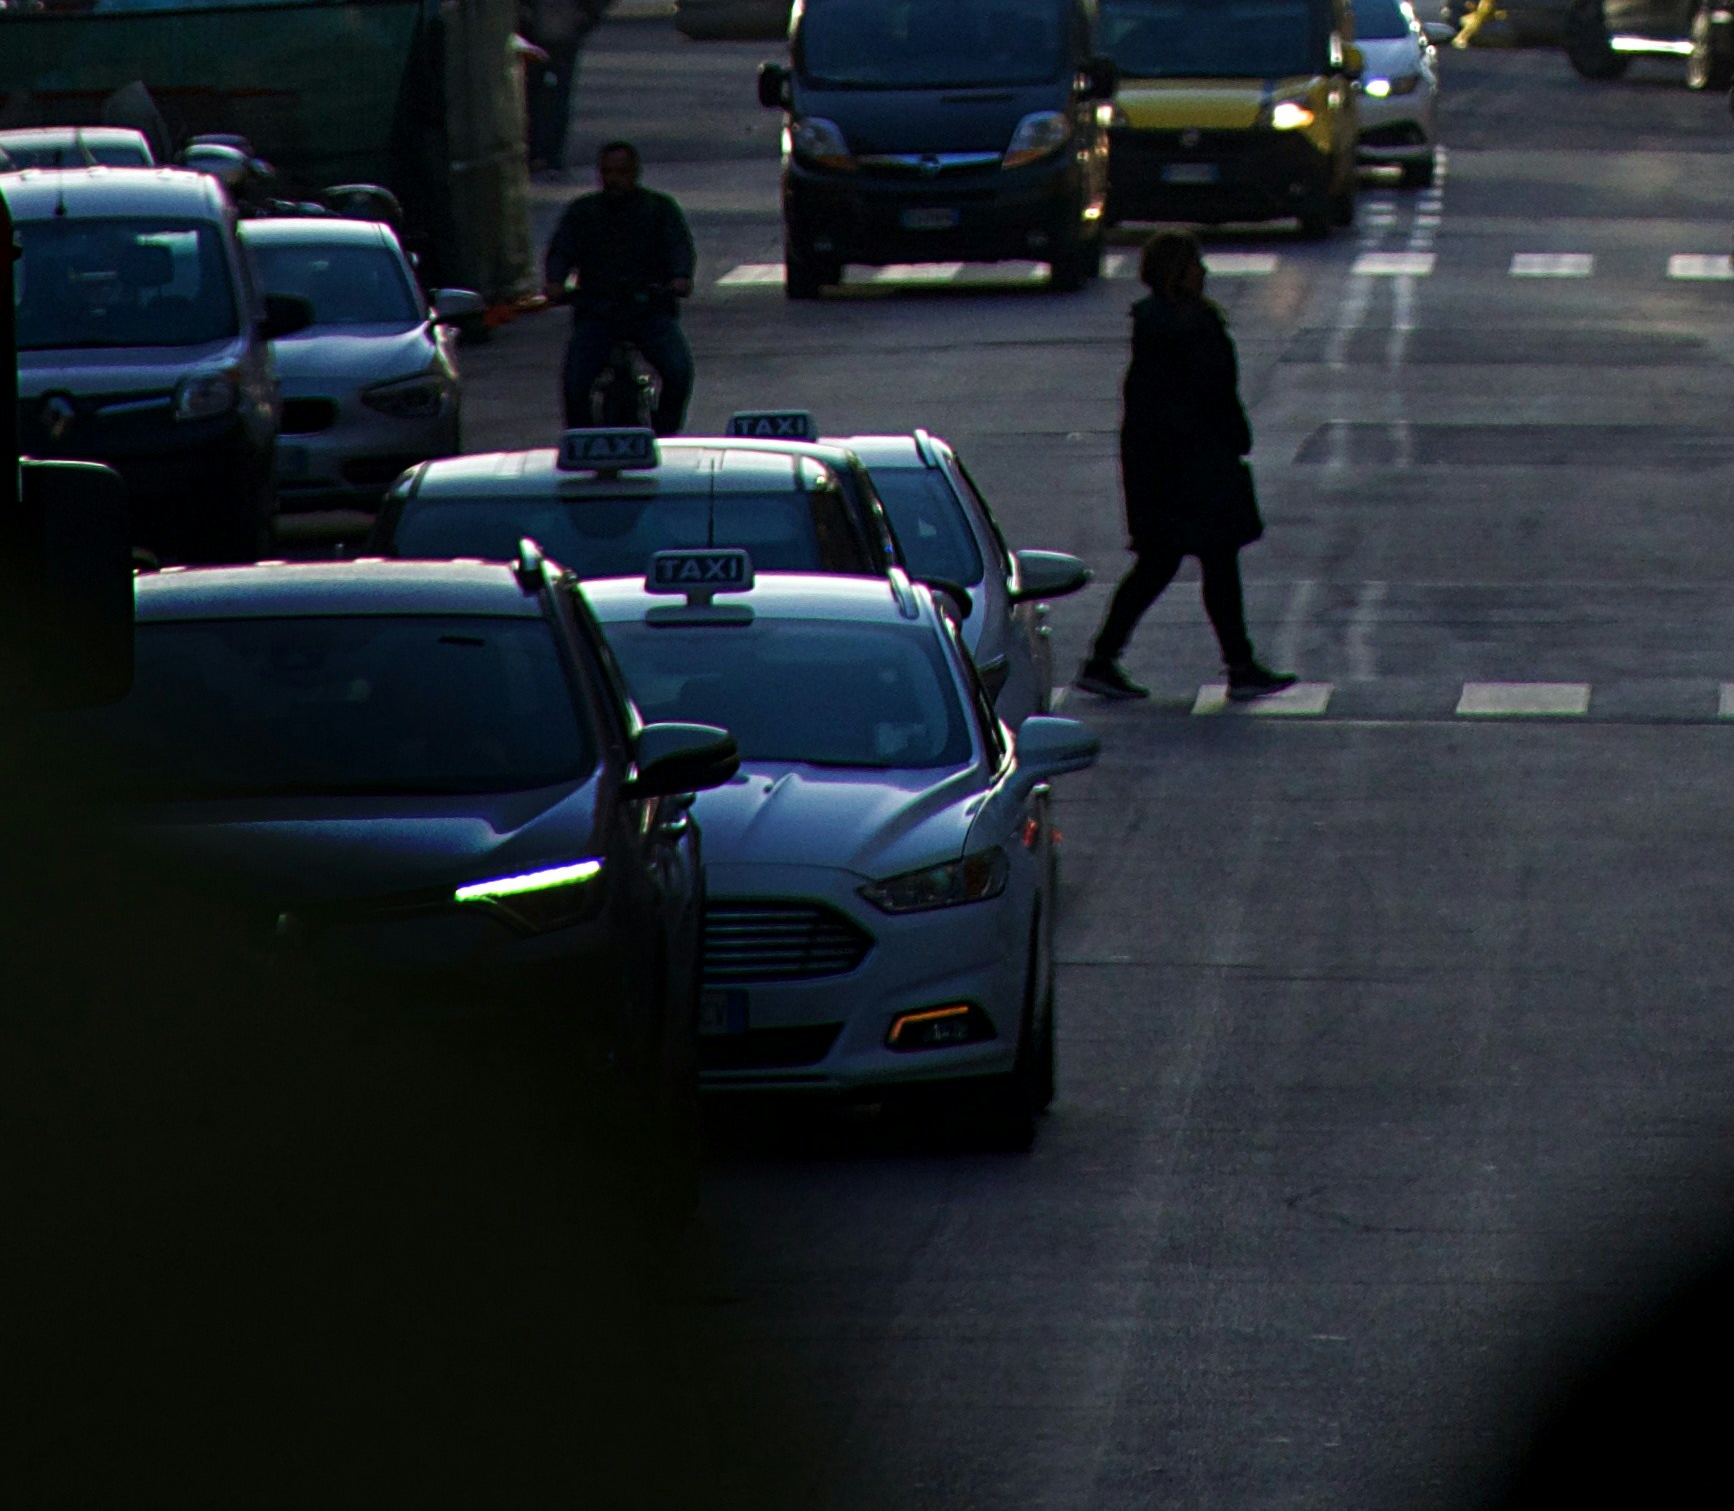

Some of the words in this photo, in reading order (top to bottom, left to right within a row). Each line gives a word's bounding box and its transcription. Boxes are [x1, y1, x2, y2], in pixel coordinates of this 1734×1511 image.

[739, 417, 805, 436] TAXI
[572, 436, 647, 457] TAXI
[660, 559, 738, 579] TAXI
